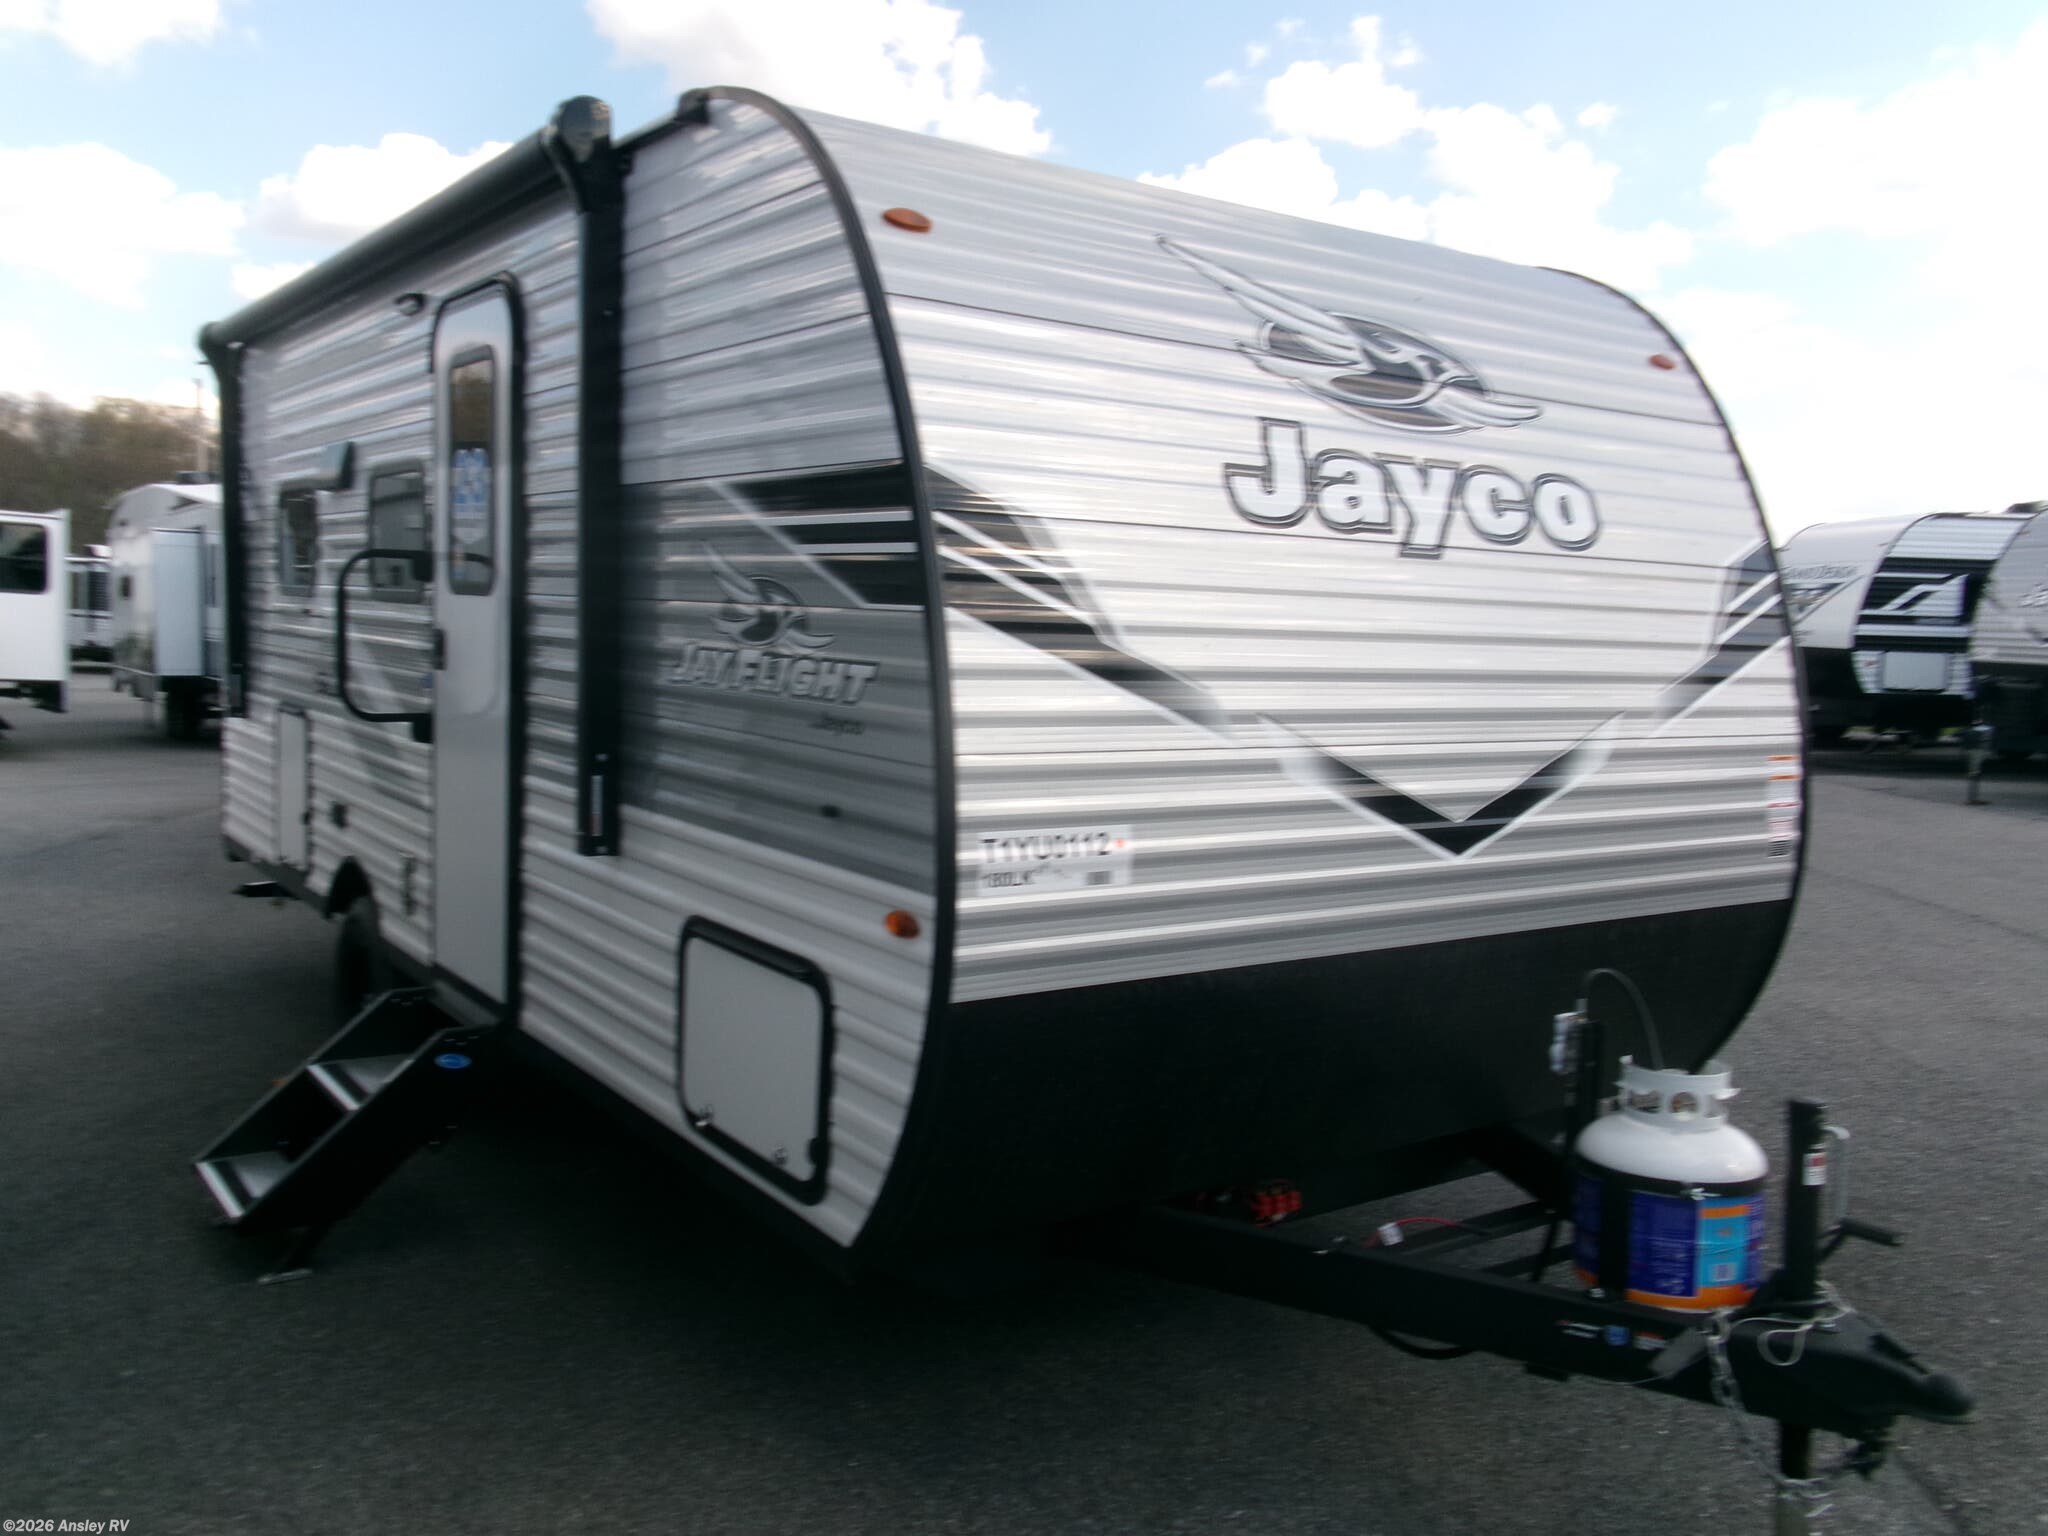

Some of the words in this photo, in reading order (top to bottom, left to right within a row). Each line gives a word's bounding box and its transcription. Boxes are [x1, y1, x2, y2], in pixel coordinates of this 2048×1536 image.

[1224, 416, 1601, 560] Jayco
[668, 642, 737, 687] JAY
[729, 649, 880, 705] FLIGHT
